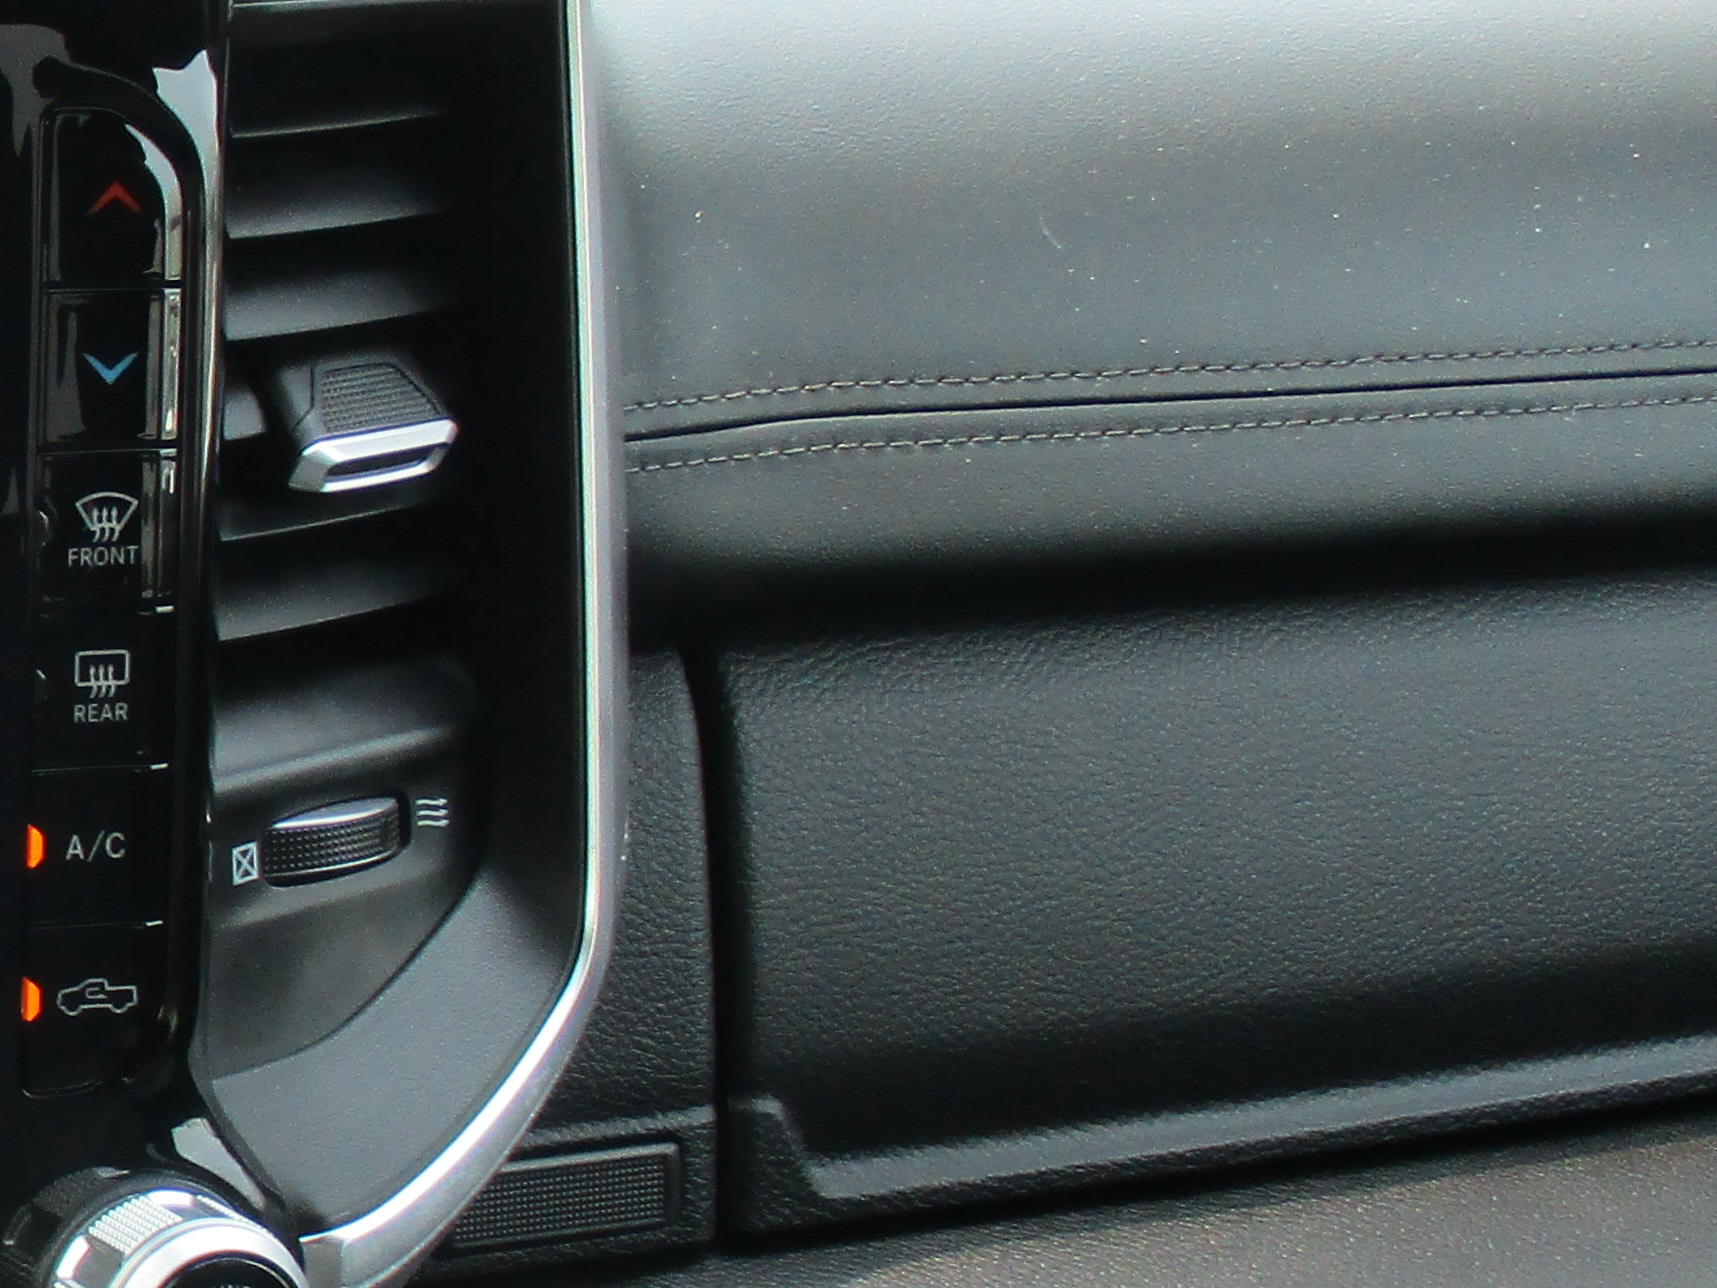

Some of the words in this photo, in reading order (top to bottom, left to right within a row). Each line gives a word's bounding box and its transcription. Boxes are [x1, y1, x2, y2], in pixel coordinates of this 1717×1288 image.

[67, 545, 139, 569] FRONT
[73, 702, 129, 724] REAR
[65, 831, 126, 862] A/C
